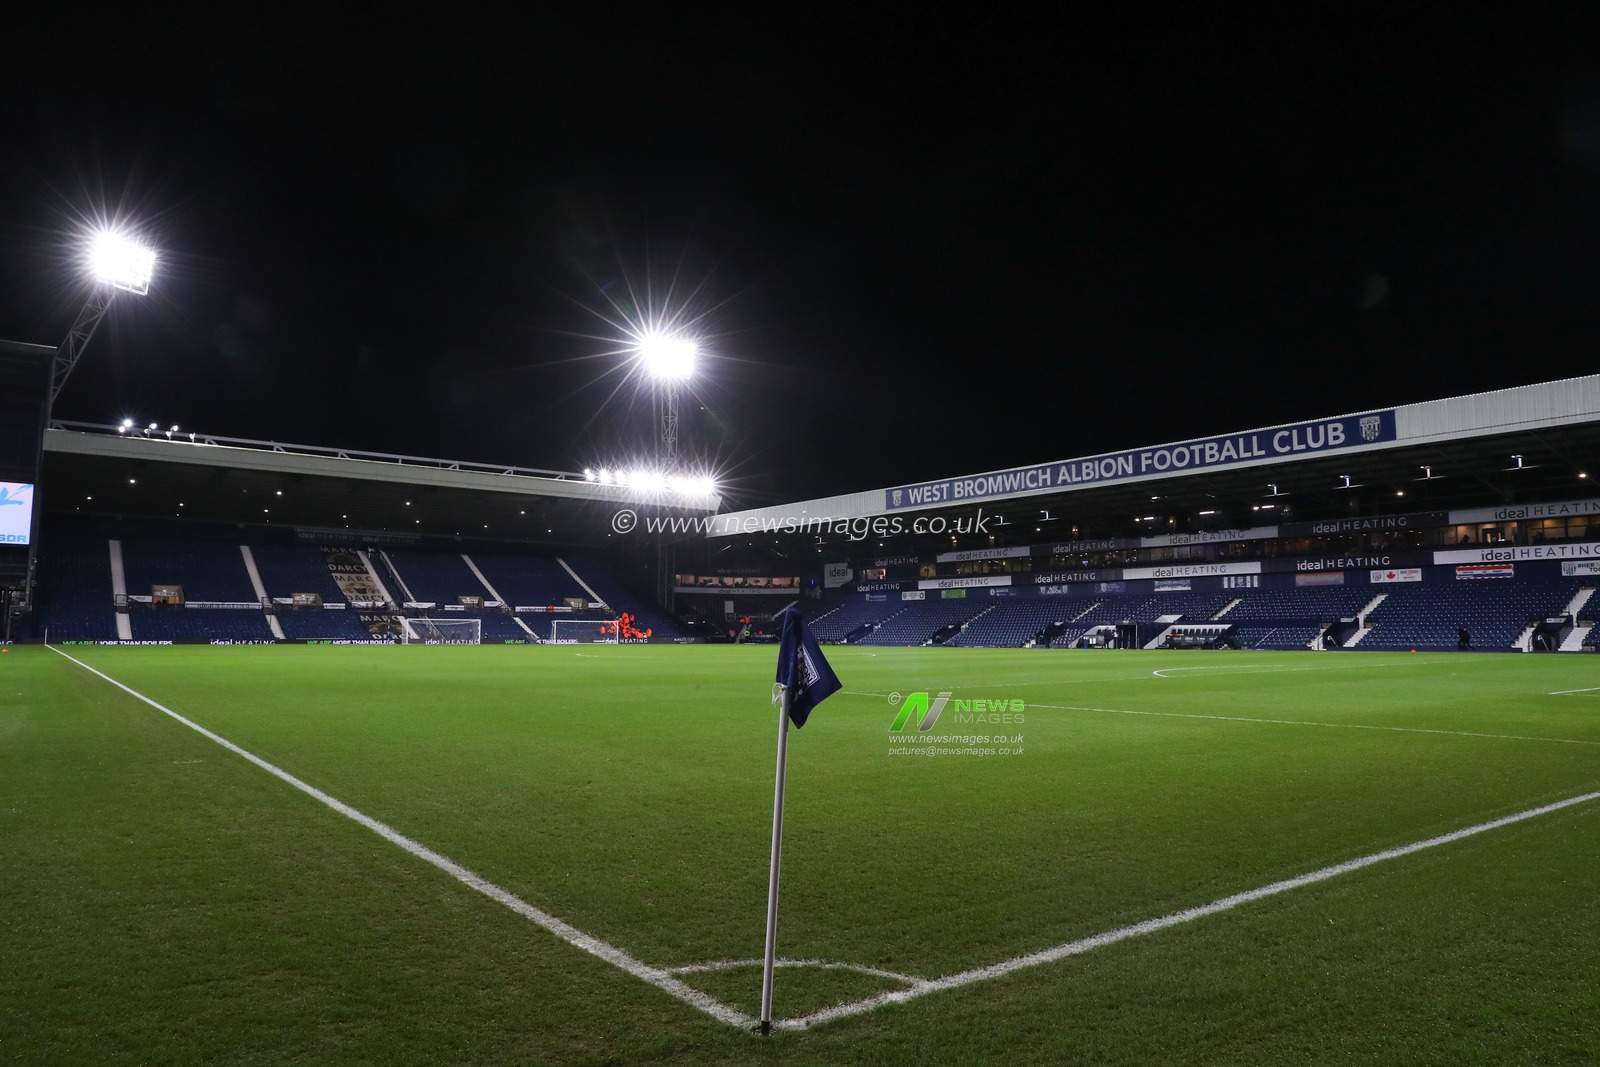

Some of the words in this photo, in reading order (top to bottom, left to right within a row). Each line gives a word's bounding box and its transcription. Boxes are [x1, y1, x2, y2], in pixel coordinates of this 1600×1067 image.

[908, 483, 951, 504] WEST
[954, 468, 1051, 499] BROMWICH
[1057, 455, 1133, 485] ALBION
[1140, 435, 1266, 473] FOOTBALL
[1273, 422, 1346, 453] CLUB
[1495, 508, 1529, 520] ideal
[1313, 522, 1340, 534] ideal
[1343, 517, 1407, 531] HEATING
[1169, 535, 1191, 545] ideal
[1194, 530, 1245, 541] HEATING
[1052, 543, 1071, 553] ideal
[1072, 540, 1116, 551] HEATING
[956, 551, 972, 561] ideal
[973, 549, 1008, 559] HEATING
[1482, 549, 1516, 561] ideal
[874, 558, 888, 567] ideal
[889, 556, 919, 565] HEATING
[1296, 559, 1324, 571] ideal
[1326, 556, 1391, 569] HEATING
[829, 566, 848, 577] ideal
[1035, 574, 1053, 583] ideal
[1054, 571, 1096, 582] HEATING
[1152, 567, 1174, 577] ideal
[1176, 565, 1227, 576] HEATING
[857, 584, 870, 592] ideal
[870, 582, 900, 591] HEATING
[938, 580, 954, 588] ideal
[954, 578, 989, 587] HEATING
